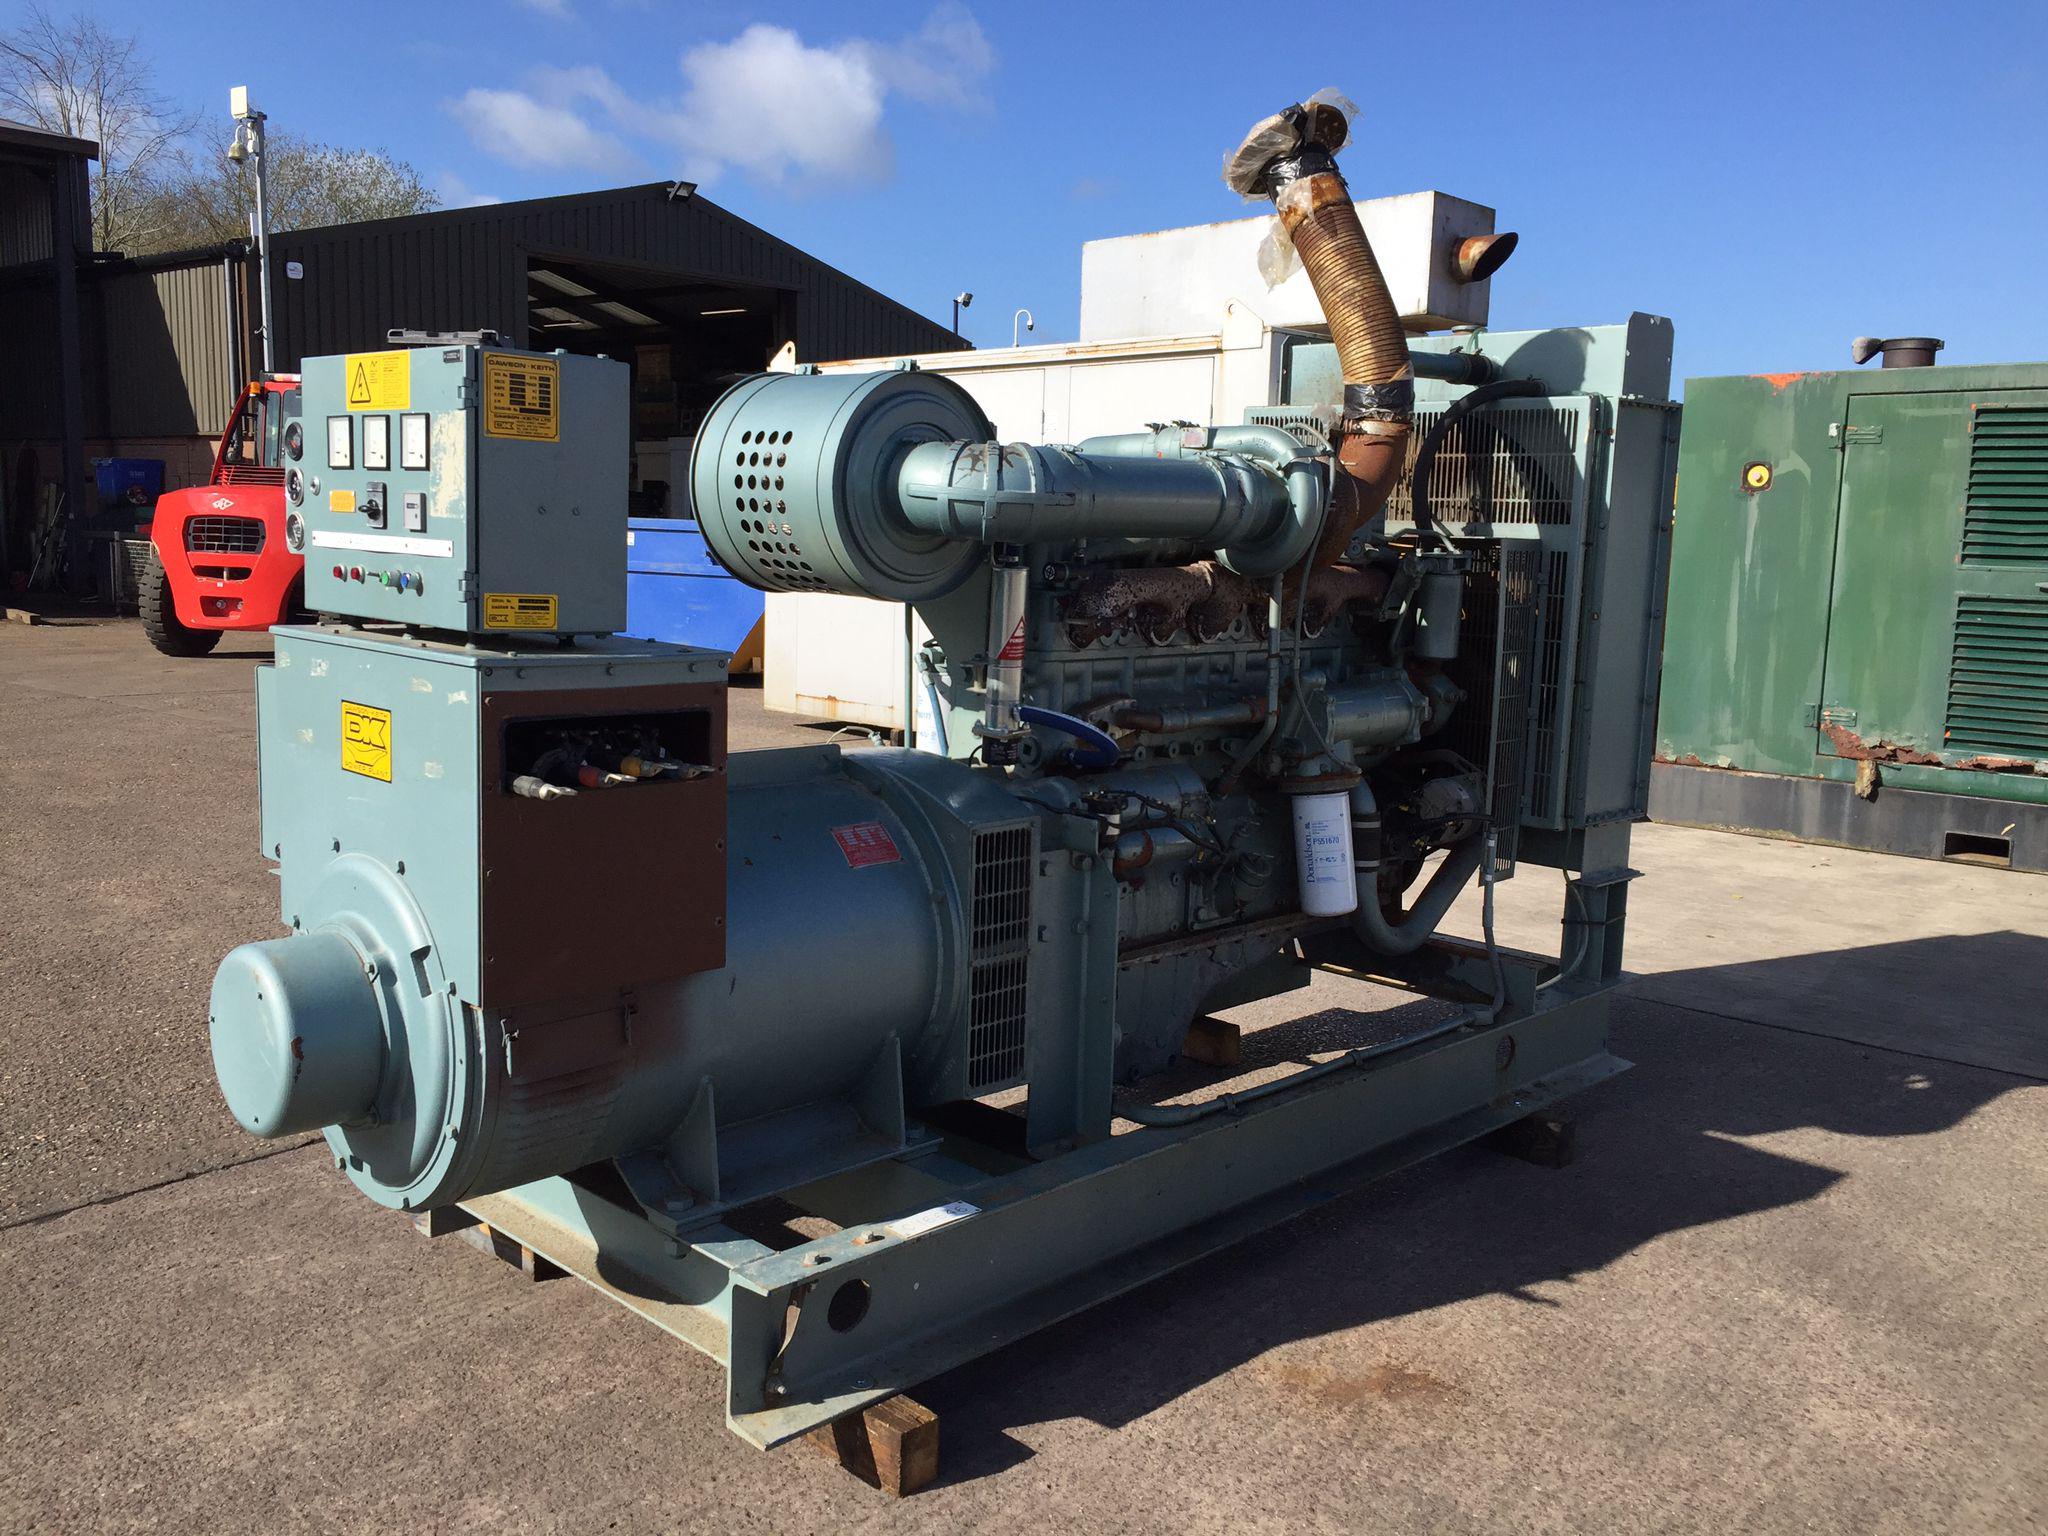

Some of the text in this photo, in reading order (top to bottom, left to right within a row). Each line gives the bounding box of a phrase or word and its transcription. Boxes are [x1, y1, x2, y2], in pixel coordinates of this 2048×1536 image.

[488, 360, 526, 369] DAWSON
[345, 711, 386, 750] DK
[1304, 835, 1315, 883] Donaldson
